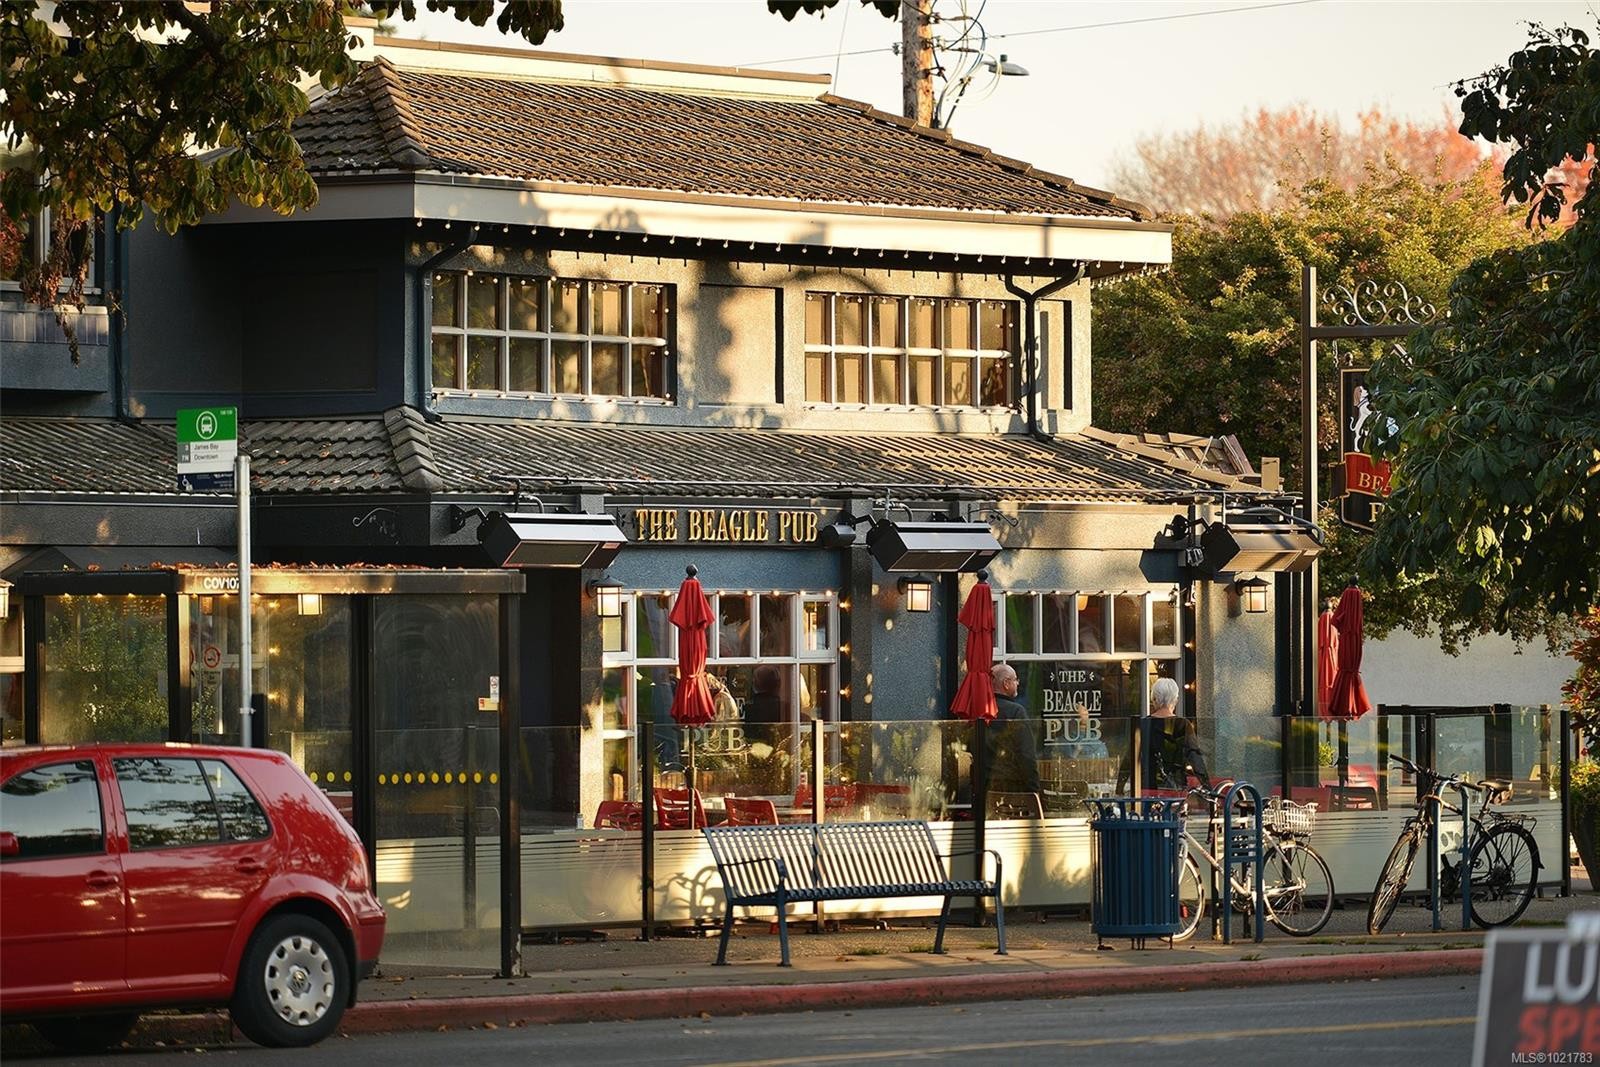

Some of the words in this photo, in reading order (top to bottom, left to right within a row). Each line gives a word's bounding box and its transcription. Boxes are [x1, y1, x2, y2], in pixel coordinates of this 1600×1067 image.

[635, 508, 678, 541] THE
[688, 509, 769, 542] BEAGLE
[778, 511, 818, 542] PUB
[1059, 670, 1087, 683] THE
[1043, 688, 1102, 712] BEAGLE
[680, 727, 746, 753] PUB
[1043, 718, 1102, 742] PUB
[1523, 941, 1600, 1003] LU
